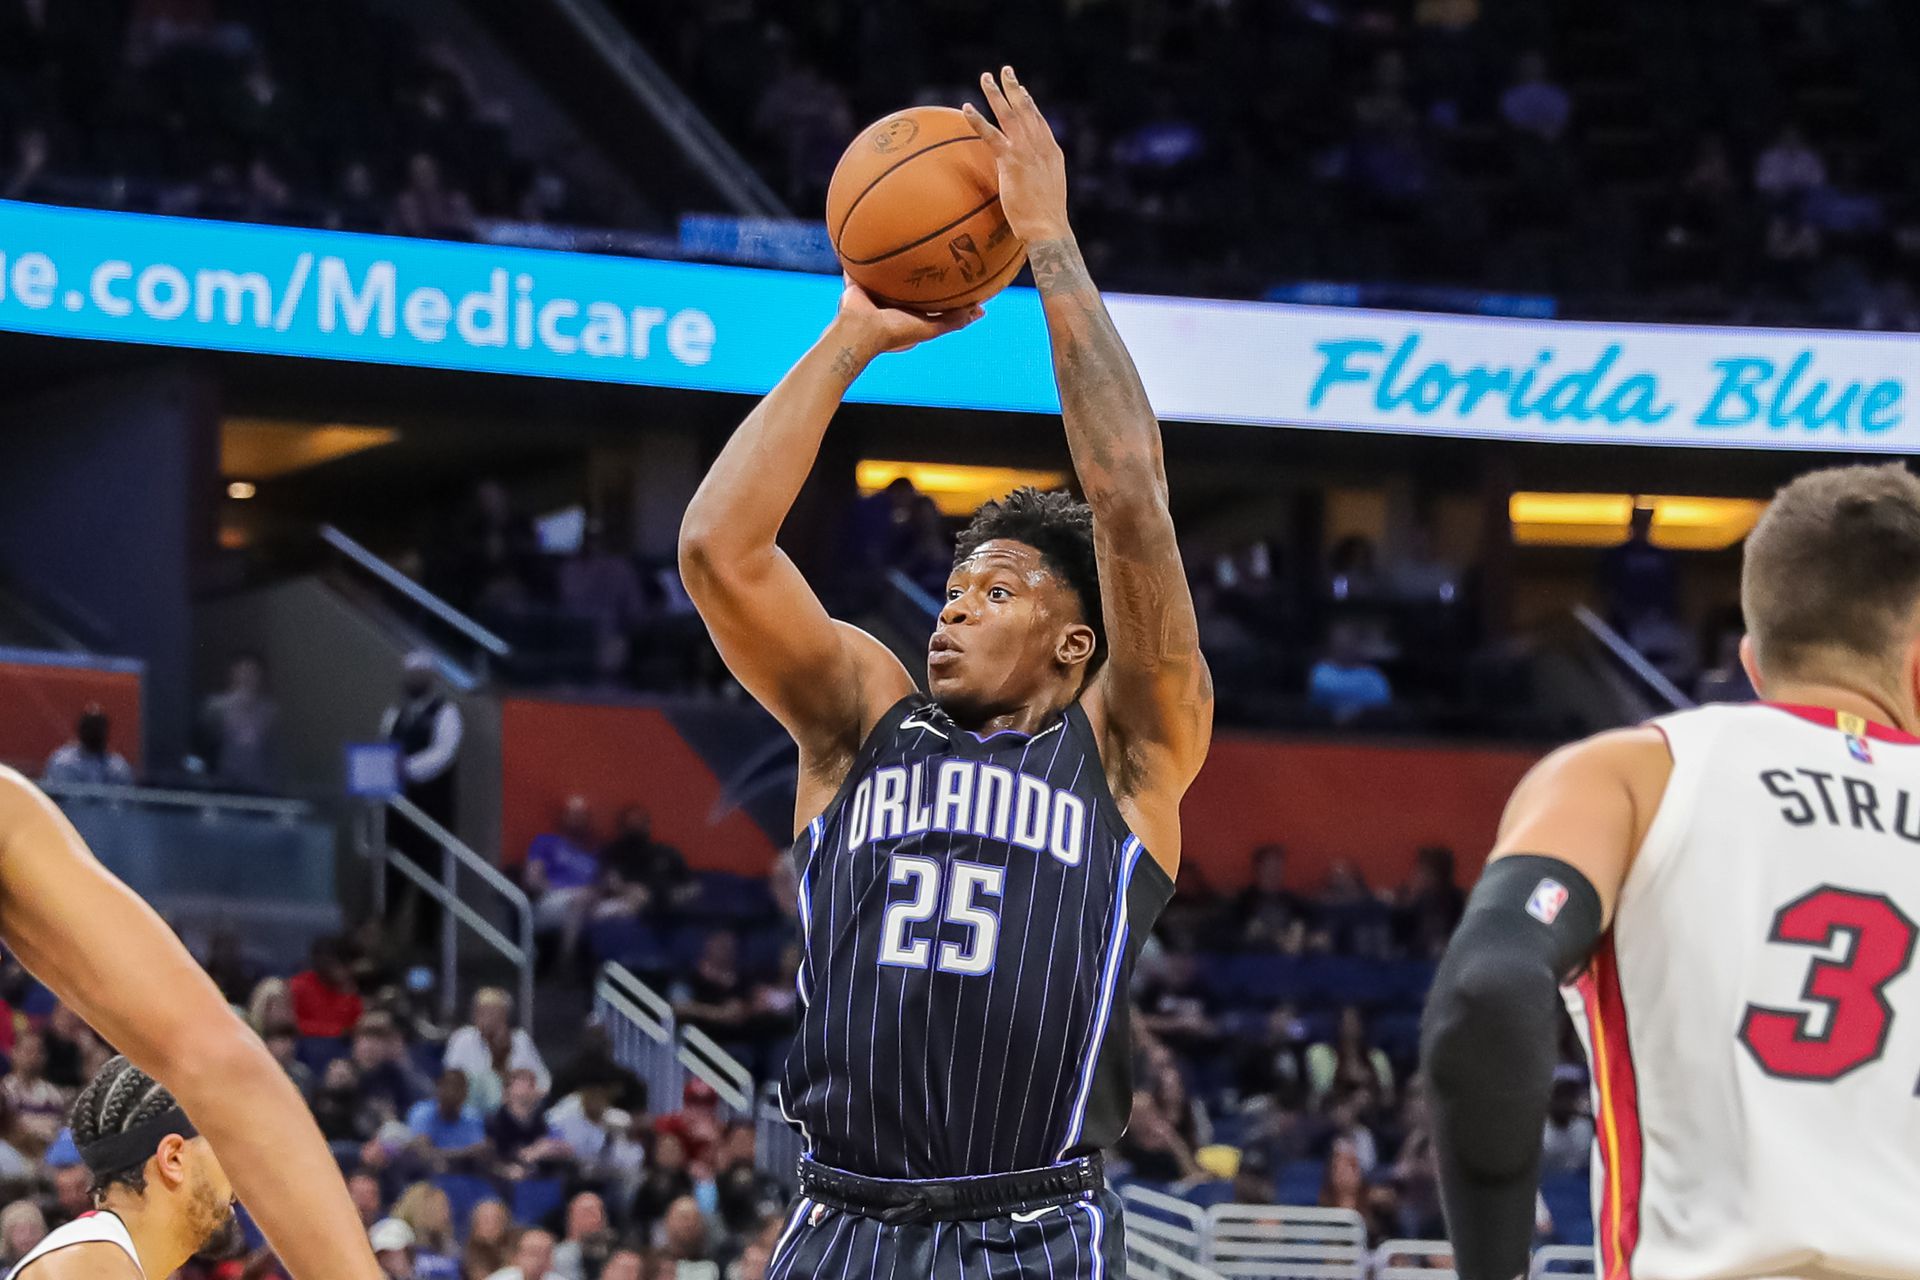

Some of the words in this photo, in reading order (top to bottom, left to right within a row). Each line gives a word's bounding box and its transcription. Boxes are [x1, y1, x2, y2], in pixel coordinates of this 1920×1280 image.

[0, 251, 718, 367] e.com/Medicare
[1307, 333, 1676, 425] Florida
[1695, 351, 1904, 433] Blue
[849, 759, 1086, 867] ORLANDO
[877, 854, 1006, 976] 25
[1737, 883, 1920, 1098] 3
